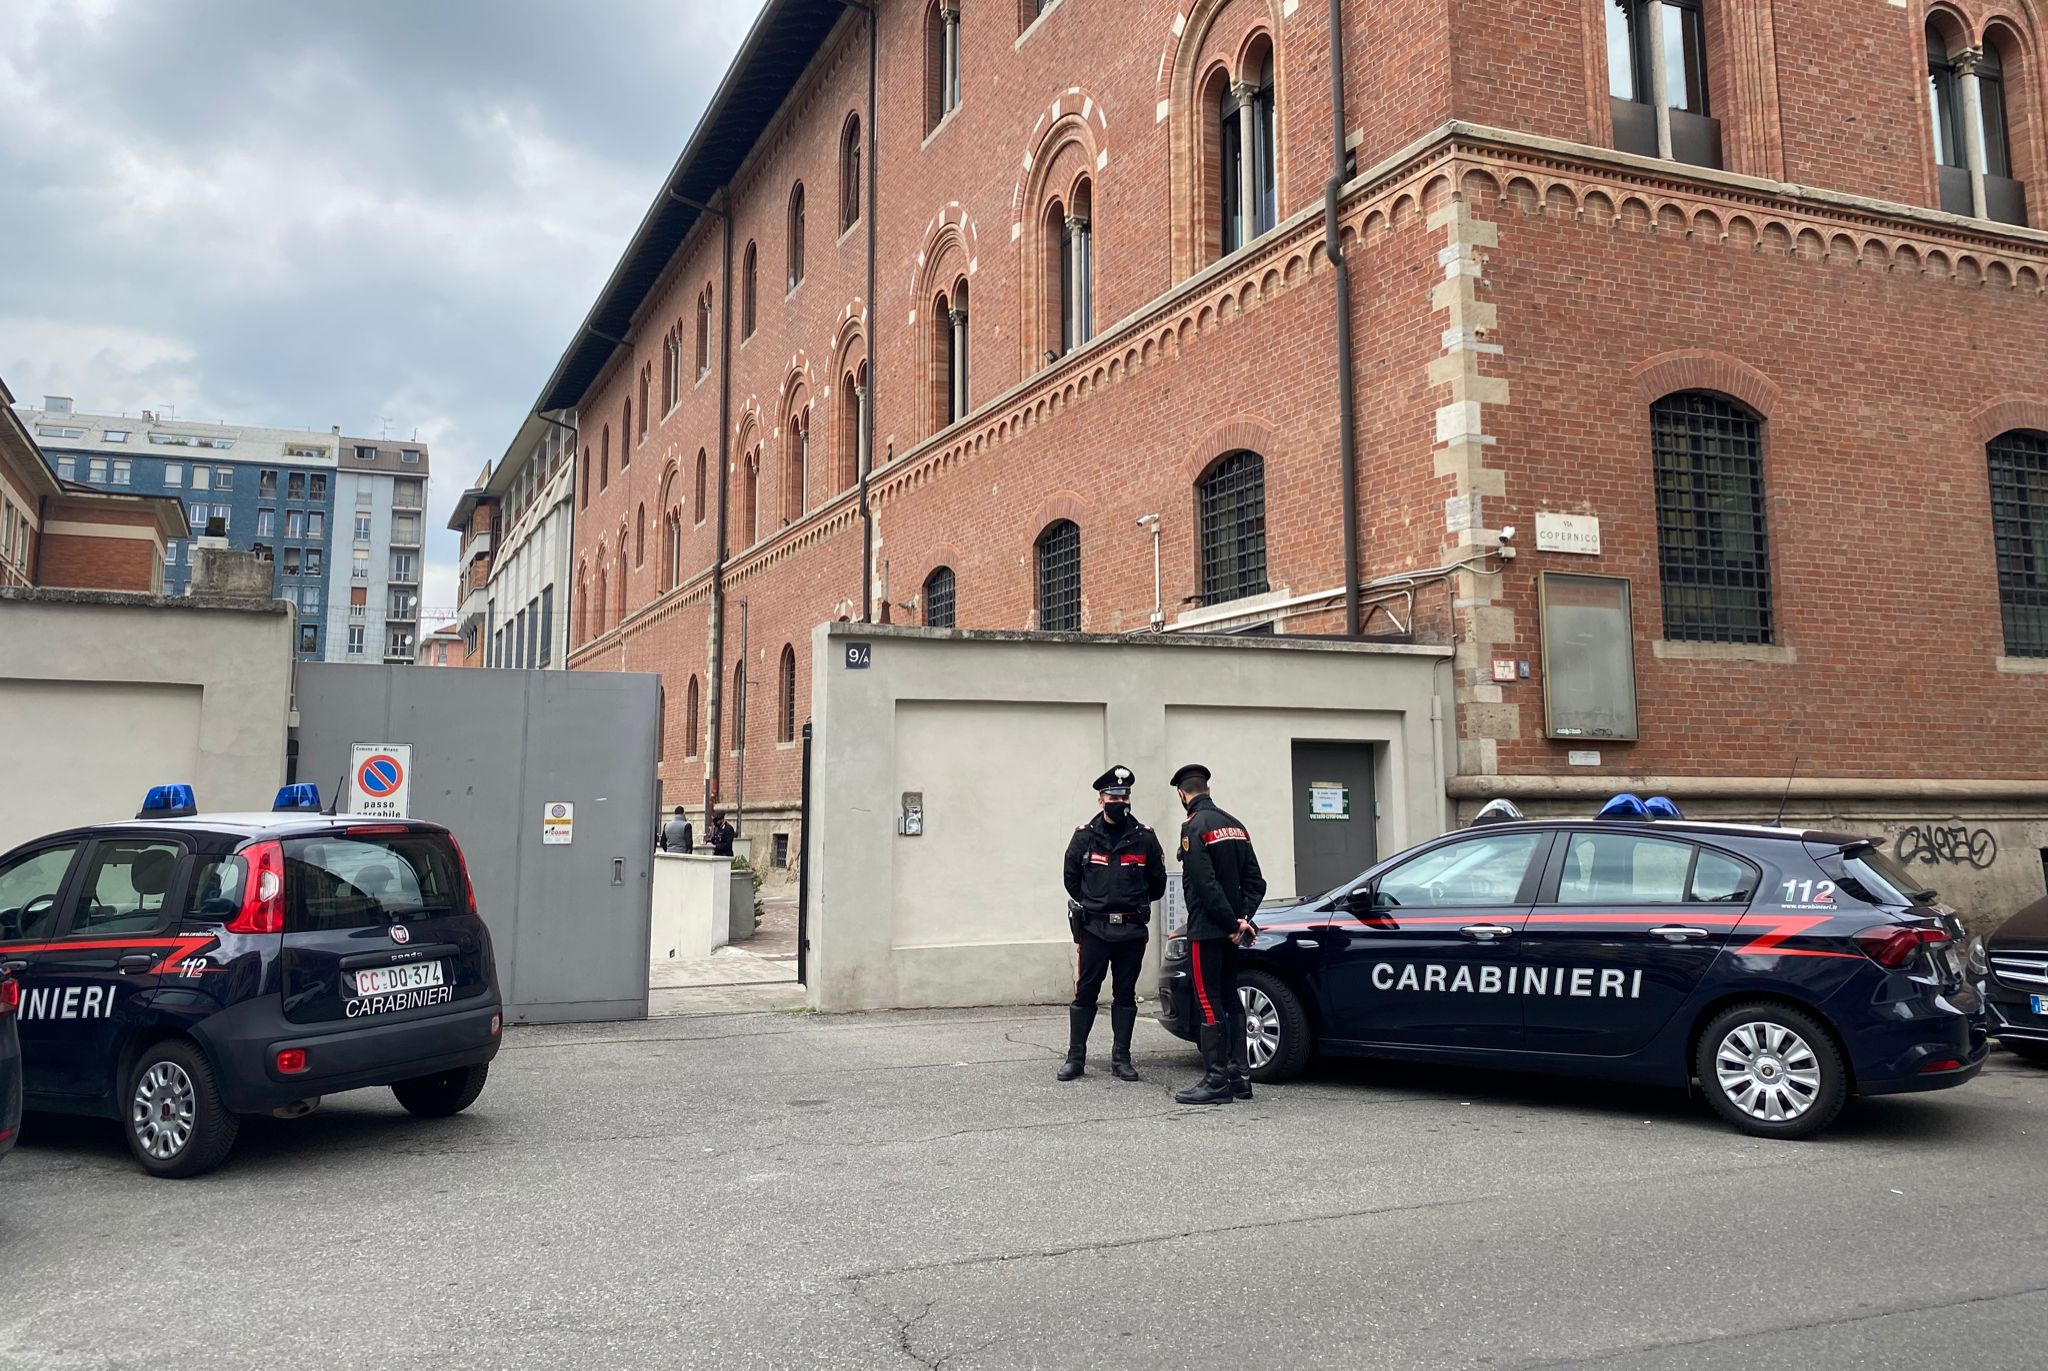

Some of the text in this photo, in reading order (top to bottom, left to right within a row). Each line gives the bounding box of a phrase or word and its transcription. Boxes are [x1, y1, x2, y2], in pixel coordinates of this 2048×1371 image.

[1563, 520, 1573, 528] VIA
[1540, 530, 1598, 543] COPERNICO
[848, 647, 870, 664] 9/A
[364, 801, 395, 809] passo
[1782, 879, 1836, 903] 112
[391, 951, 423, 961] panda
[179, 957, 208, 978] 112
[360, 971, 380, 993] CC
[412, 960, 441, 985] 374
[1371, 962, 1643, 999] CARABINIERI
[17, 985, 117, 1020] INIERI
[345, 985, 454, 1018] CARABINIERI
